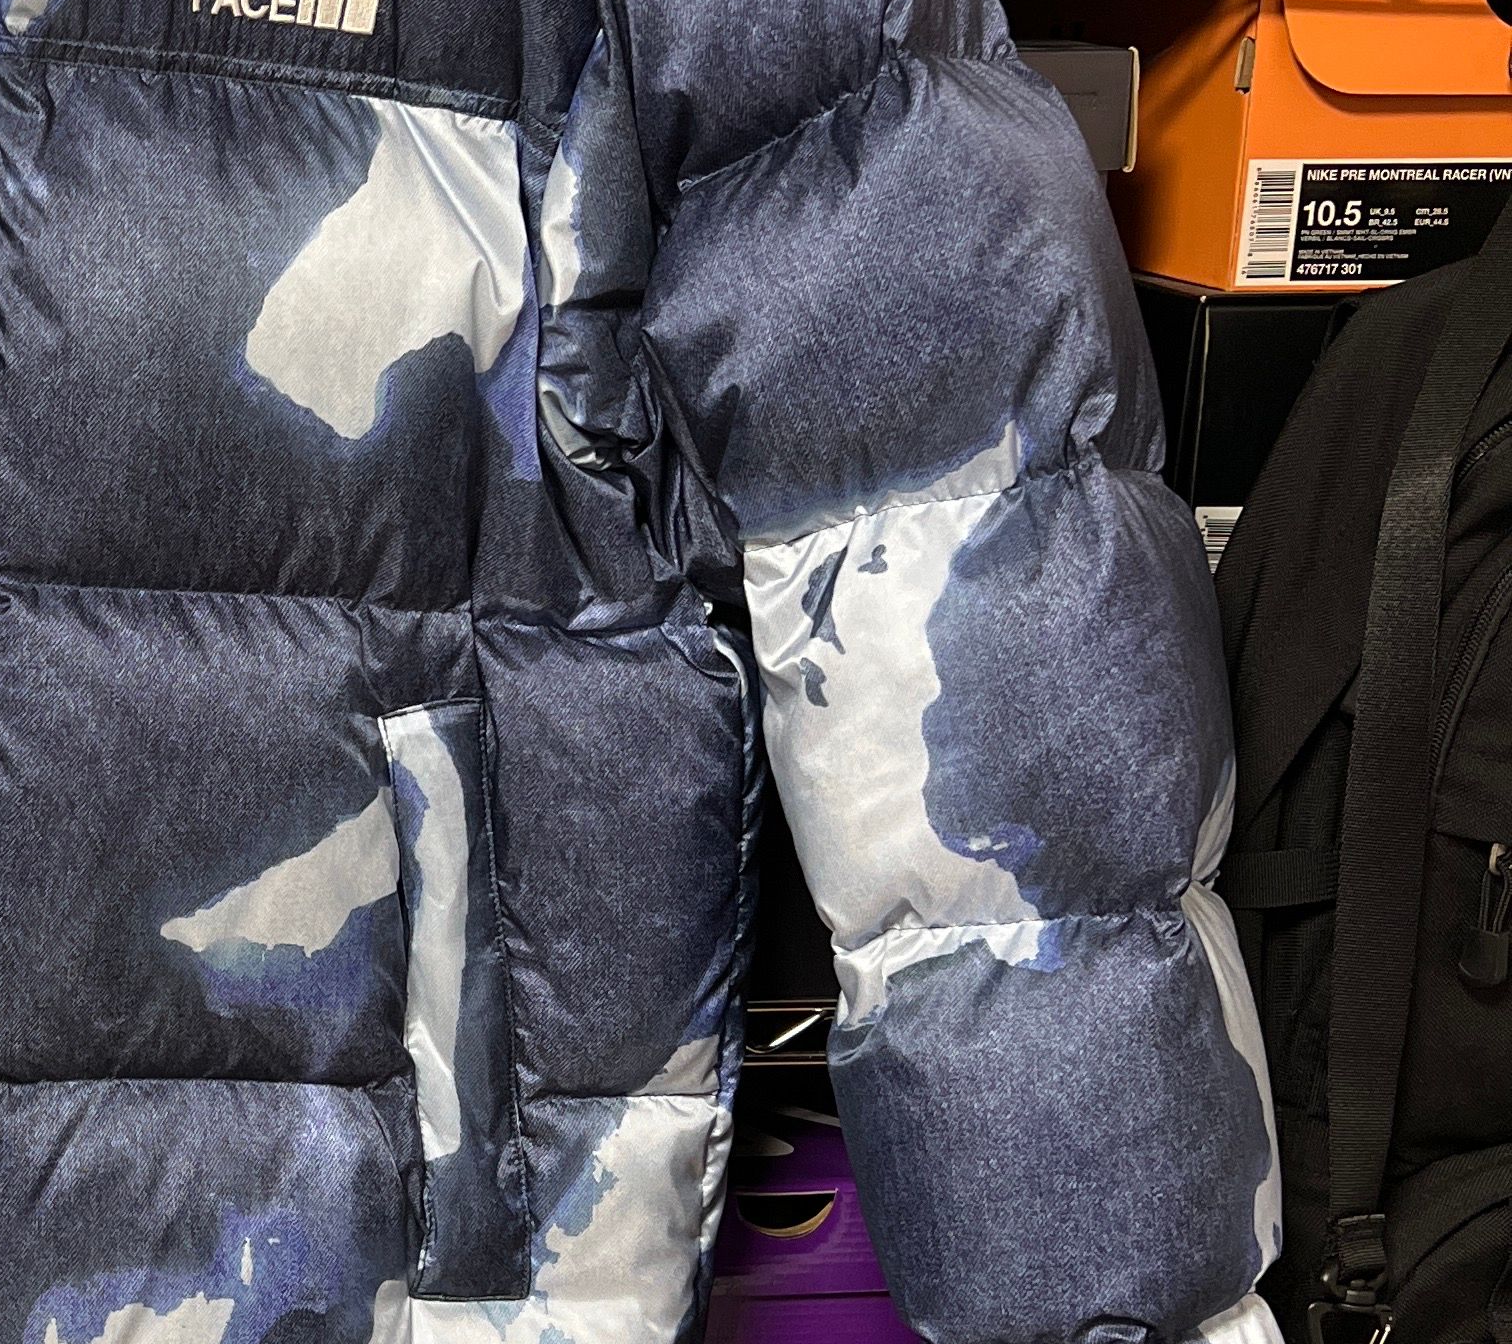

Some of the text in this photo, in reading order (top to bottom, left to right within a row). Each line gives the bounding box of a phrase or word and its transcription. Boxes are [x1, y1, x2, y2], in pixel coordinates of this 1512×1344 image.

[1307, 169, 1487, 181] NIKE PRE MONTREAL RACER
[1302, 199, 1363, 227] 10.5
[1296, 263, 1363, 275] 476717 301
